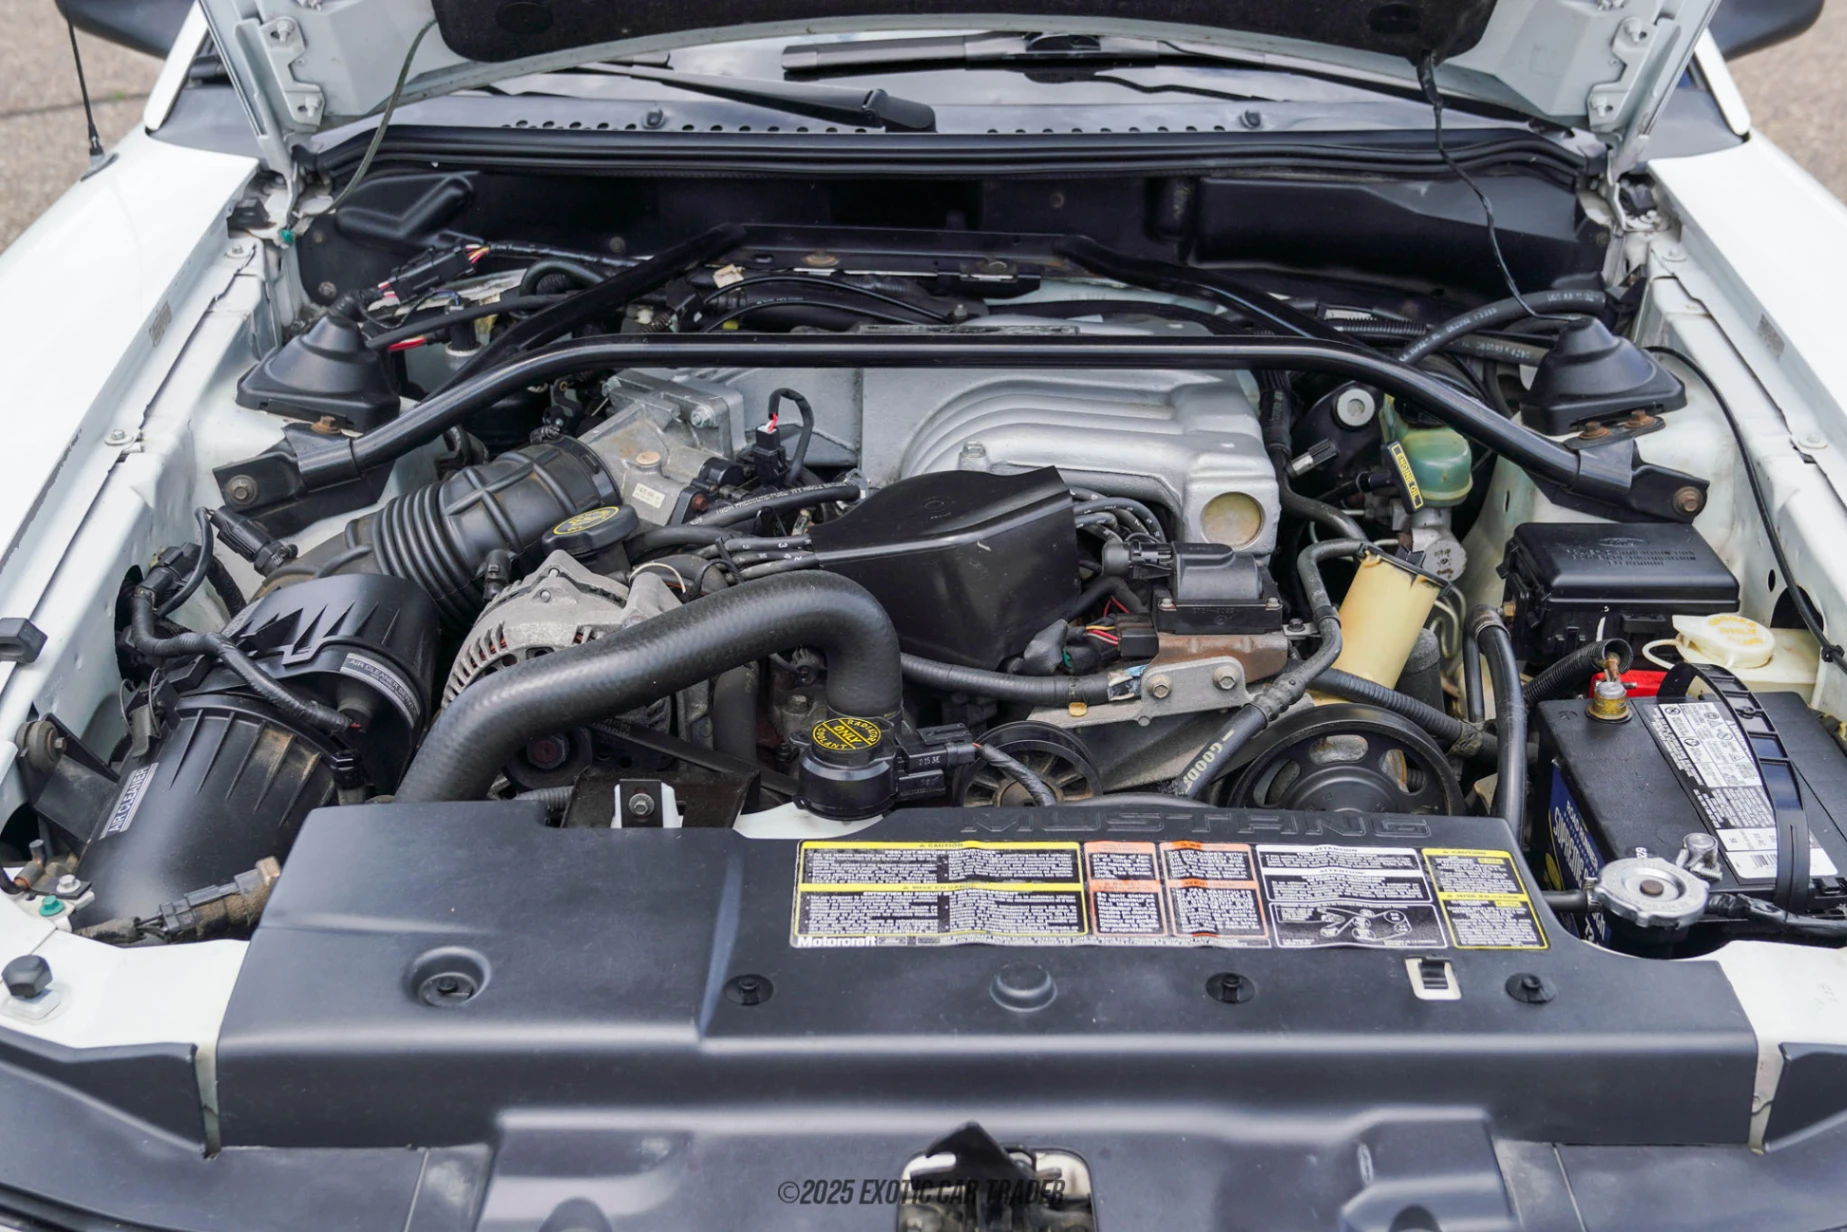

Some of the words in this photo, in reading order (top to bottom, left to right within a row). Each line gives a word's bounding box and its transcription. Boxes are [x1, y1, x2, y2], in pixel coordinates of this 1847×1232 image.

[1396, 452, 1413, 484] ENGINE
[1410, 485, 1419, 500] OIL
[349, 660, 364, 668] AIR
[365, 663, 399, 689] CLEANER
[817, 728, 848, 750] COOLANT
[833, 725, 862, 744] ONLY
[848, 719, 878, 742] RADIATOR
[108, 814, 127, 832] AIR
[118, 766, 150, 814] CLEANER
[961, 812, 1431, 838] MUSTANG
[1566, 800, 1580, 831] ROAD
[1553, 806, 1585, 890] SUPREME
[797, 936, 877, 947] Motorcraft
